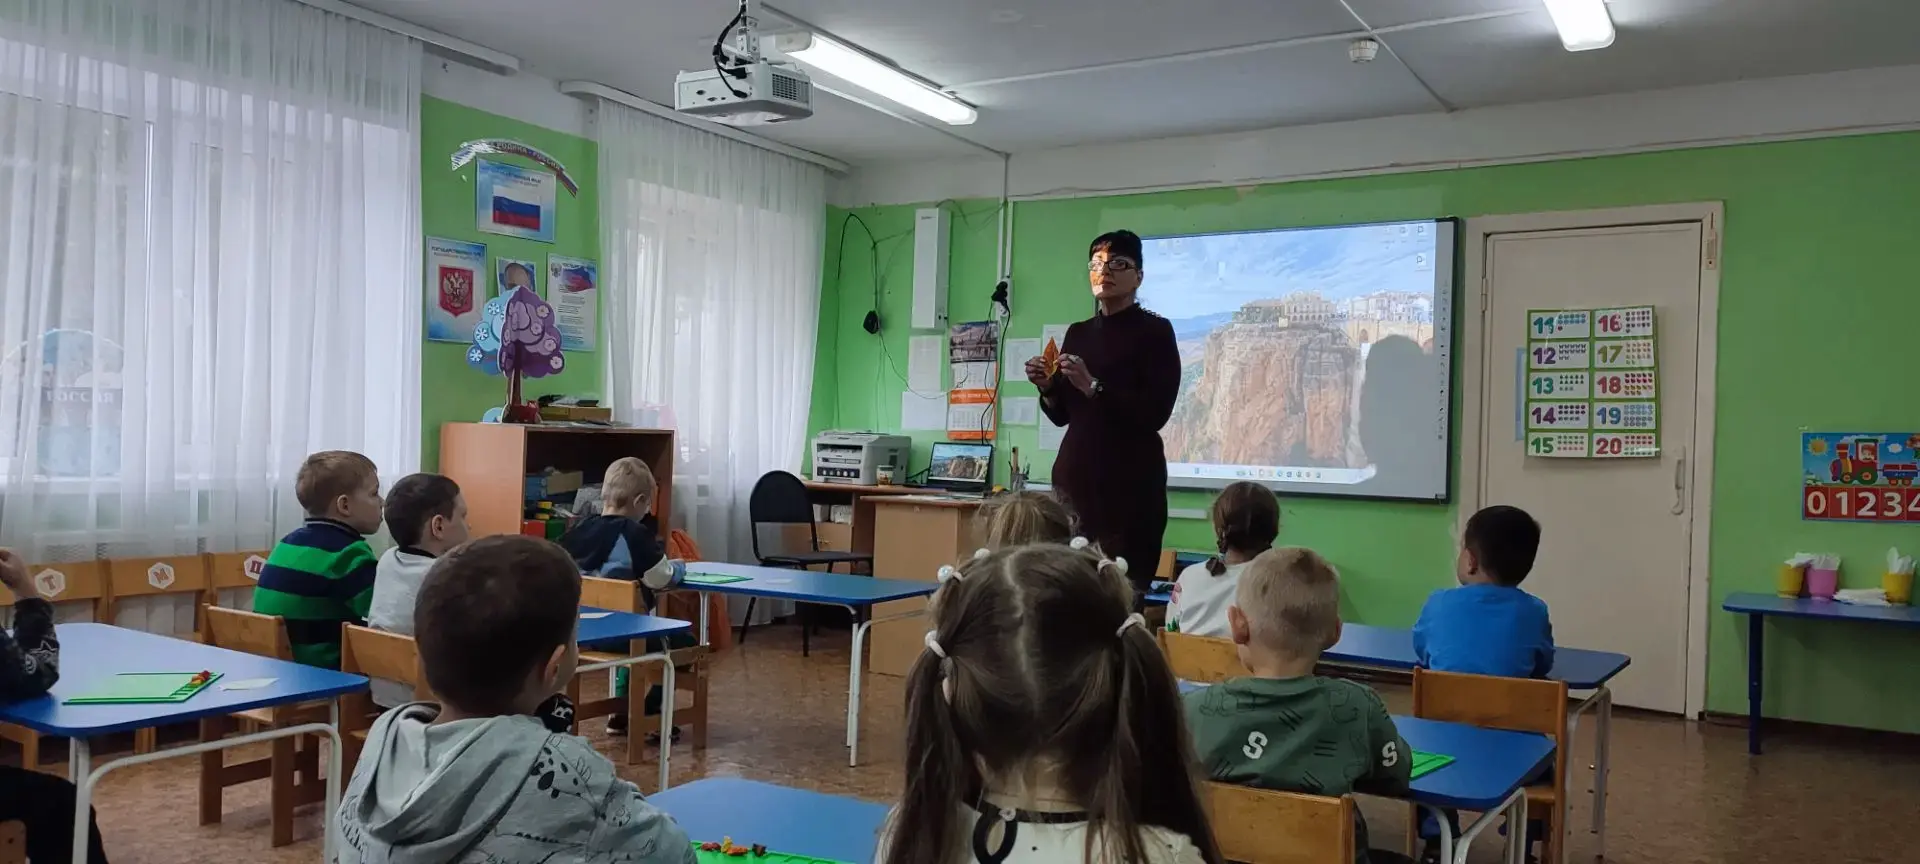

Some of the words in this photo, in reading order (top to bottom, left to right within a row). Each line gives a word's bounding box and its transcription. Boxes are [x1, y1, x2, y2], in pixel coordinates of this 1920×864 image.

[1533, 316, 1554, 334] 11
[1598, 314, 1622, 333] 16
[1533, 347, 1556, 365] 12
[1598, 345, 1624, 364] 17
[1532, 376, 1554, 395] 13
[1597, 376, 1622, 394] 18
[1532, 407, 1556, 425] 14
[1597, 406, 1621, 425] 19
[1531, 437, 1554, 454] 15
[1596, 437, 1622, 455] 20
[1807, 491, 1827, 515] 0
[1836, 491, 1849, 516] 1
[1857, 491, 1877, 517] 2
[1883, 491, 1903, 517] 3
[42, 574, 56, 592] Т
[1242, 730, 1268, 760] S
[1381, 740, 1398, 768] S
